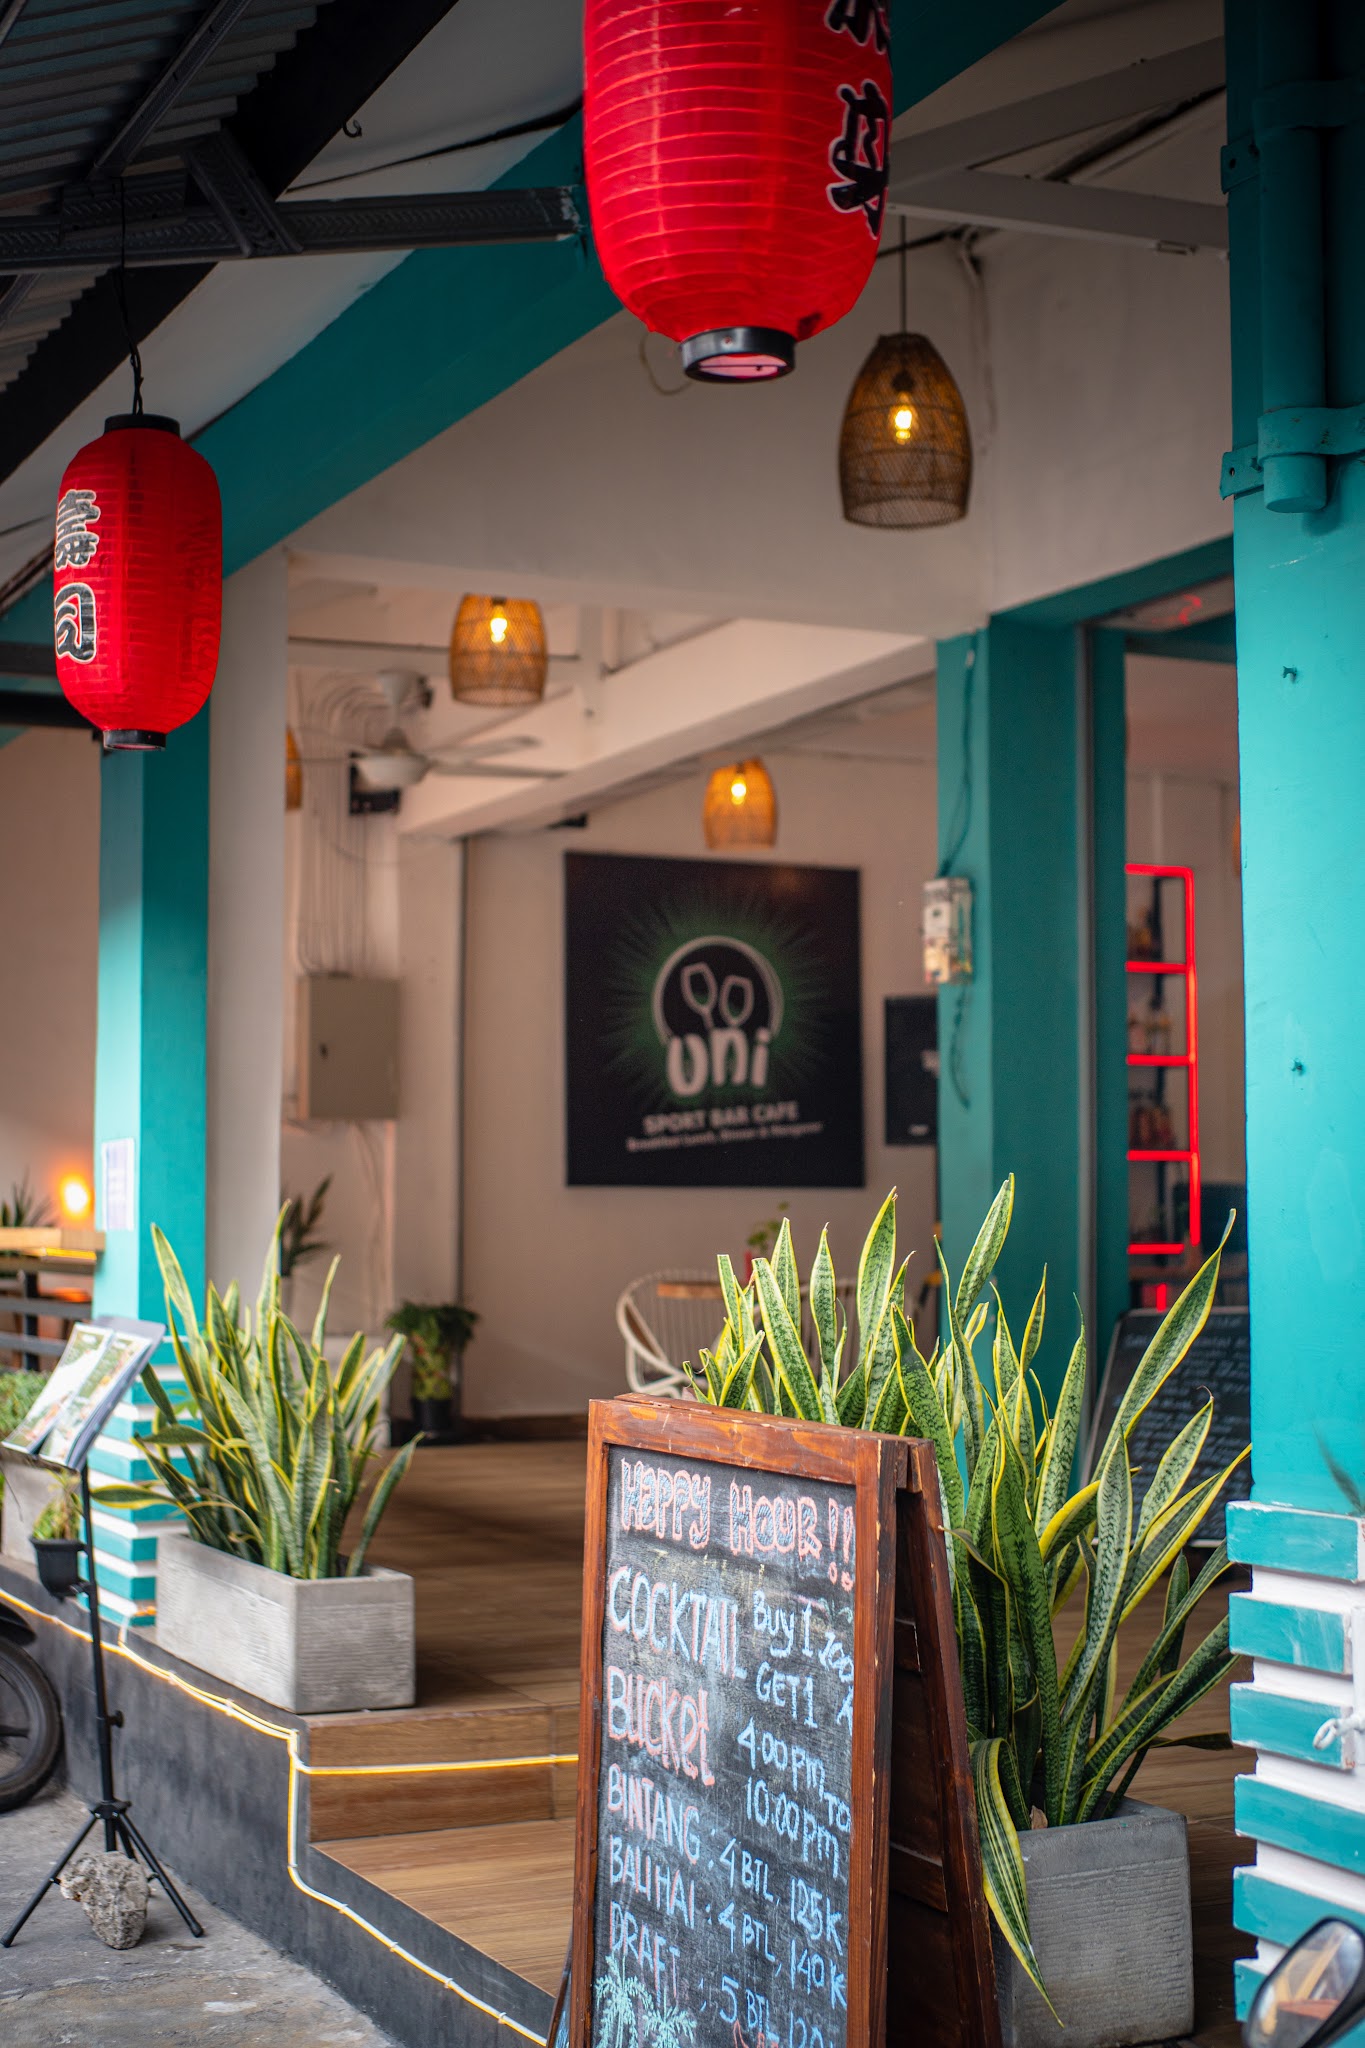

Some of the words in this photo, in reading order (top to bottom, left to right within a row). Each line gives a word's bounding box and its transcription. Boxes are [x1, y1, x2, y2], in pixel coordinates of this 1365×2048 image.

[642, 1110, 706, 1135] SPORT
[710, 1105, 749, 1127] BAR
[752, 1101, 798, 1122] CAFE
[608, 1565, 748, 1680] COCKTAIL
[608, 1763, 700, 1865] BINTANG
[719, 1974, 739, 2024] 5
